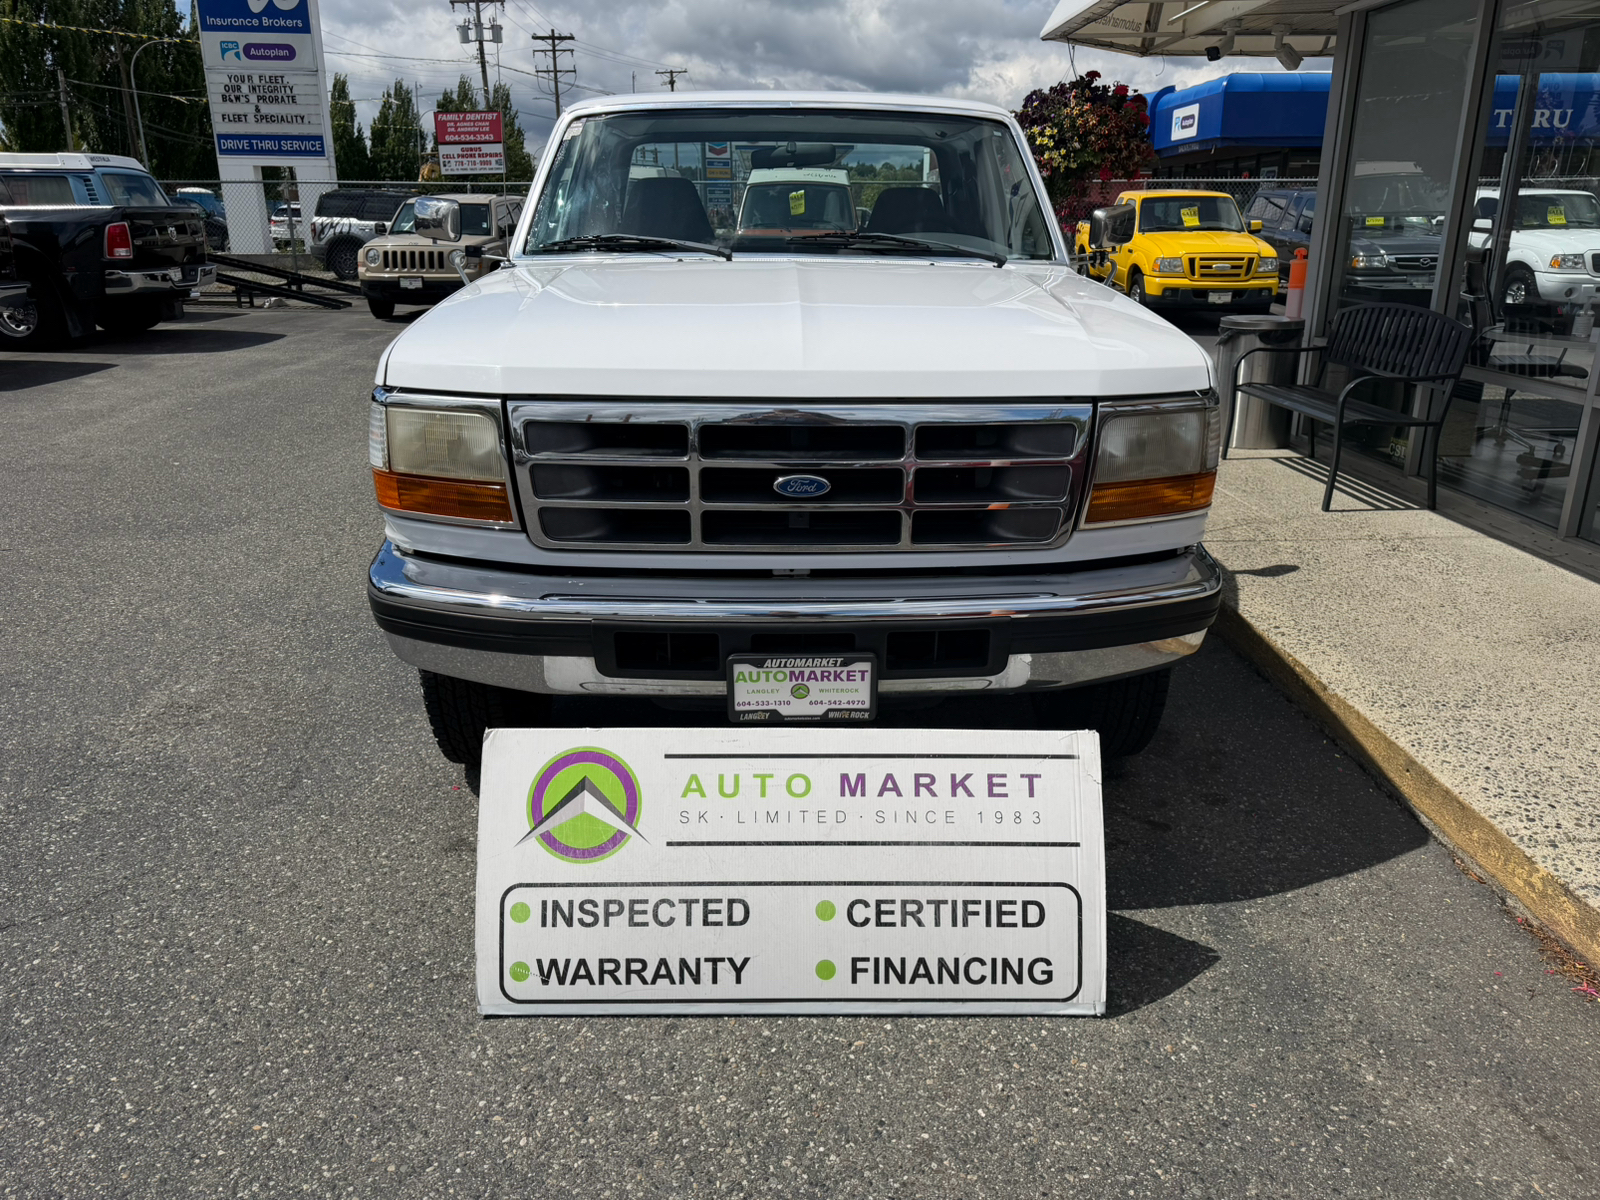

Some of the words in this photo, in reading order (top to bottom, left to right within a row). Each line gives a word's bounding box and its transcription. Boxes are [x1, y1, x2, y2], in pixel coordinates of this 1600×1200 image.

[206, 15, 259, 26] Insurance
[262, 17, 303, 28] Brokers
[250, 47, 290, 58] Autoplan
[227, 74, 254, 84] YOUR
[258, 75, 290, 84] FLEET.
[224, 84, 242, 94] OUR
[248, 85, 294, 94] INTEGRITY
[221, 94, 250, 104] B&W'S
[256, 95, 297, 104] PRORATE
[254, 104, 261, 114] &
[221, 114, 249, 123] FLEET
[437, 113, 465, 121] FAMILY
[1493, 109, 1574, 128] TRU
[220, 139, 250, 149] DRIVE
[251, 140, 279, 150] THRU
[280, 140, 322, 151] SERVICE
[787, 479, 817, 492] Ford
[763, 657, 844, 668] AUTOMARKET
[735, 670, 869, 683] AUTOMARKET
[739, 711, 770, 721] LANGLEY
[828, 711, 850, 719] WHITE
[850, 711, 870, 719] ROCK
[681, 773, 813, 798] AUTO
[840, 773, 1042, 798] MARKET
[737, 810, 847, 824] LIMITED
[875, 810, 955, 824] SINCE
[977, 810, 1042, 824] 1983
[540, 898, 751, 928] INSPECTED
[847, 898, 1046, 928] CERTIFIED
[536, 956, 751, 986] WARRANTY
[850, 956, 1054, 986] FINANCING
